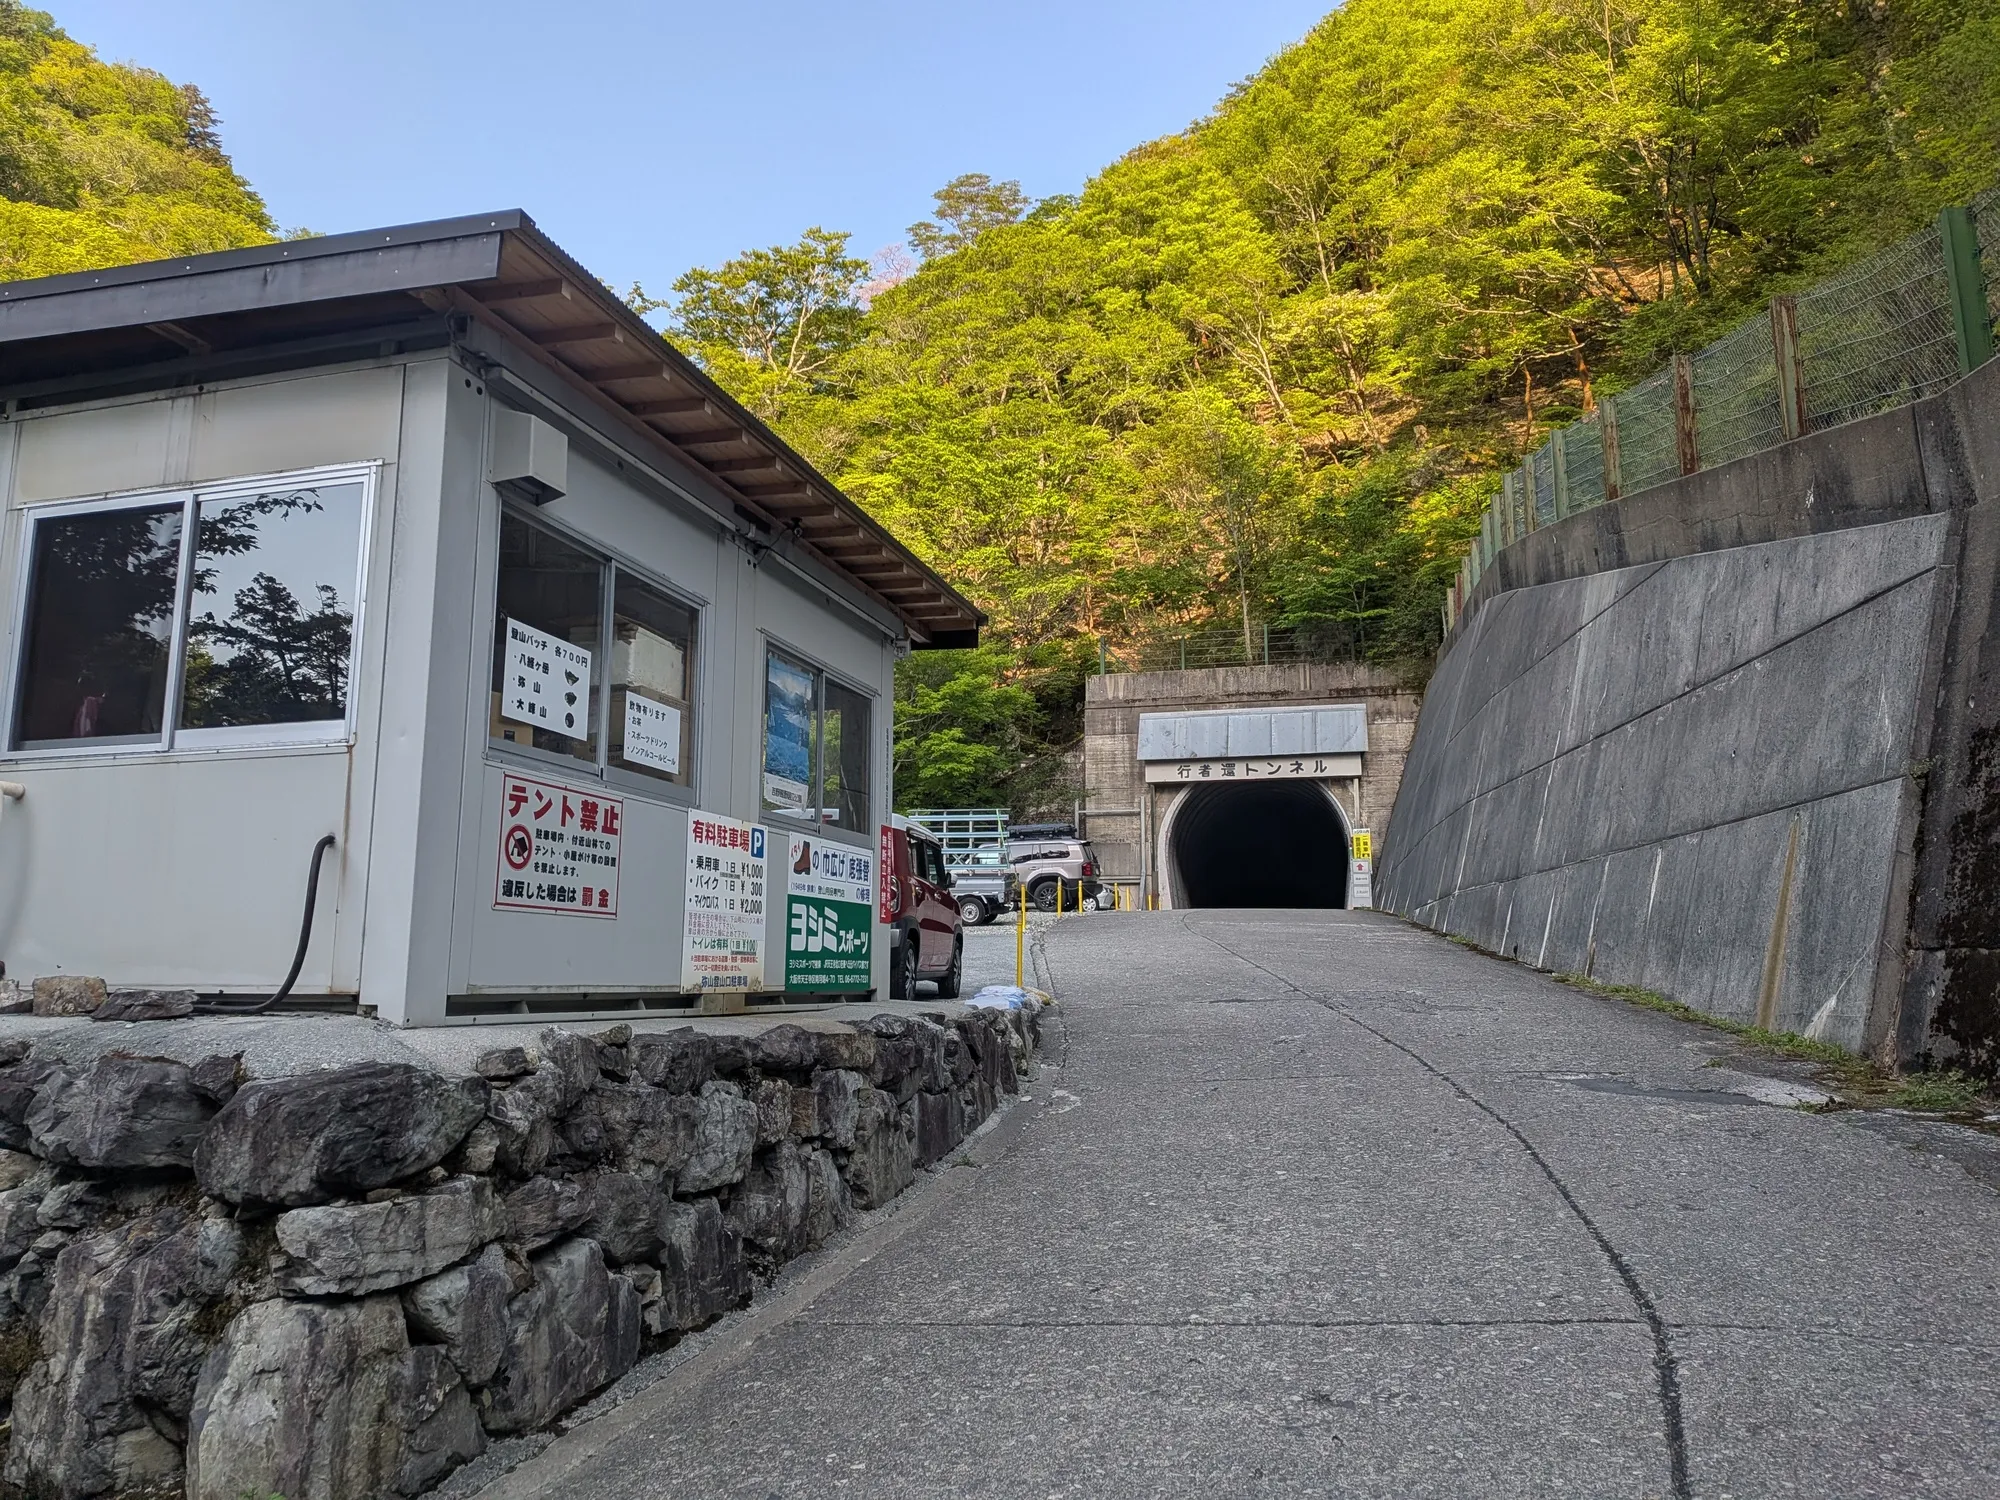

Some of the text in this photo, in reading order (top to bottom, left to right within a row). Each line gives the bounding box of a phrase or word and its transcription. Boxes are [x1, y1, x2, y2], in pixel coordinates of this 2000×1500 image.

[510, 627, 548, 651] 登山バッチ
[629, 700, 666, 721] 飲物有ります
[632, 716, 642, 727] お茶
[631, 731, 668, 749] スポーツドリンク
[630, 745, 676, 766] ノンアルコールビール
[1177, 760, 1328, 779] 行者還トンネル
[508, 784, 619, 836] テント禁止
[535, 828, 611, 851] 駐車場内・付近山林での
[692, 819, 762, 855] 有料駐車場 P
[534, 845, 617, 868] テント・小屋がけ等の設置
[696, 855, 720, 872] 乗用車
[725, 861, 736, 873] 1日
[741, 862, 764, 879] ¥1,000
[812, 850, 869, 882] の 巾広げ 底張替
[533, 862, 579, 878] を禁止します。
[502, 879, 610, 908] 違反した場合は 罰金
[695, 875, 719, 890] バイク
[724, 880, 735, 891] 1日
[694, 895, 763, 915] マイクロバス 1日 ¥2,000
[856, 887, 870, 902] の修理
[791, 903, 868, 955] ヨシミ スポーツ
[692, 937, 729, 950] トイレは有料
[701, 975, 748, 988] 弥山登山口駐車場
